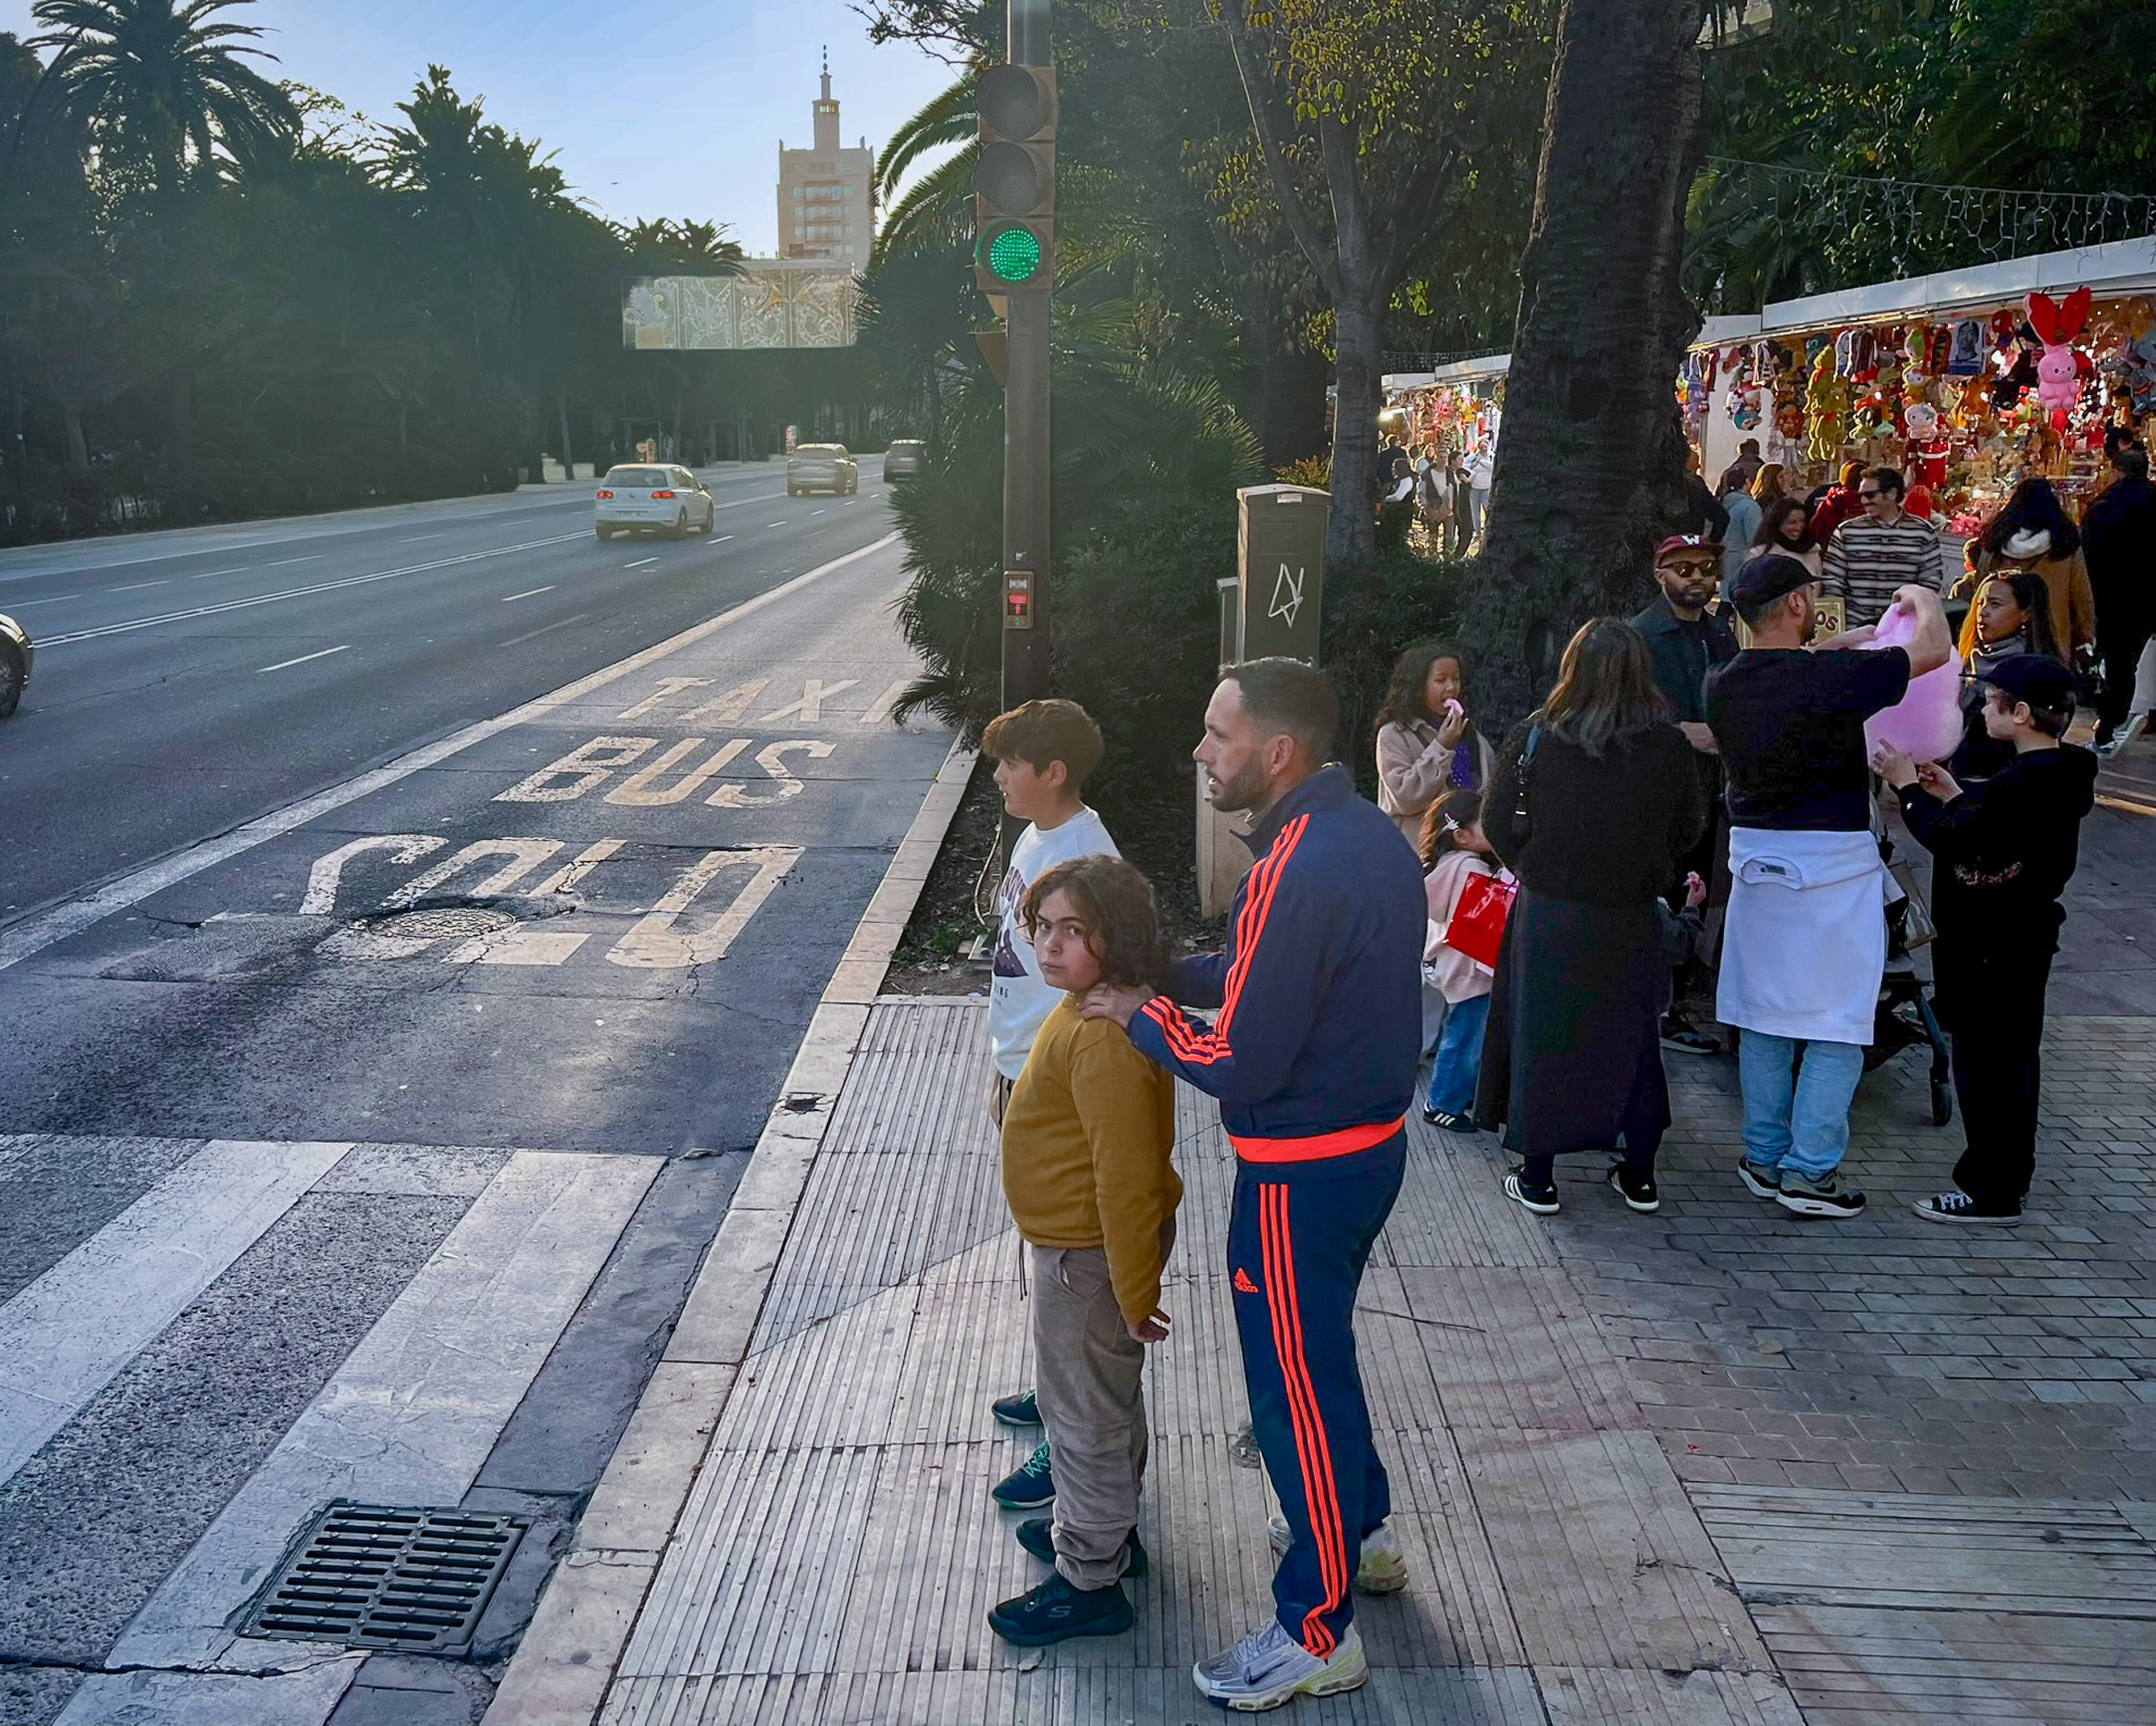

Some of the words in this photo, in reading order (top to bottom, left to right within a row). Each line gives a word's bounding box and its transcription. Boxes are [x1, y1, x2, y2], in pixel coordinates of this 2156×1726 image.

[1681, 534, 1700, 545] W
[617, 677, 918, 724] TAXI
[492, 735, 837, 808] BUS
